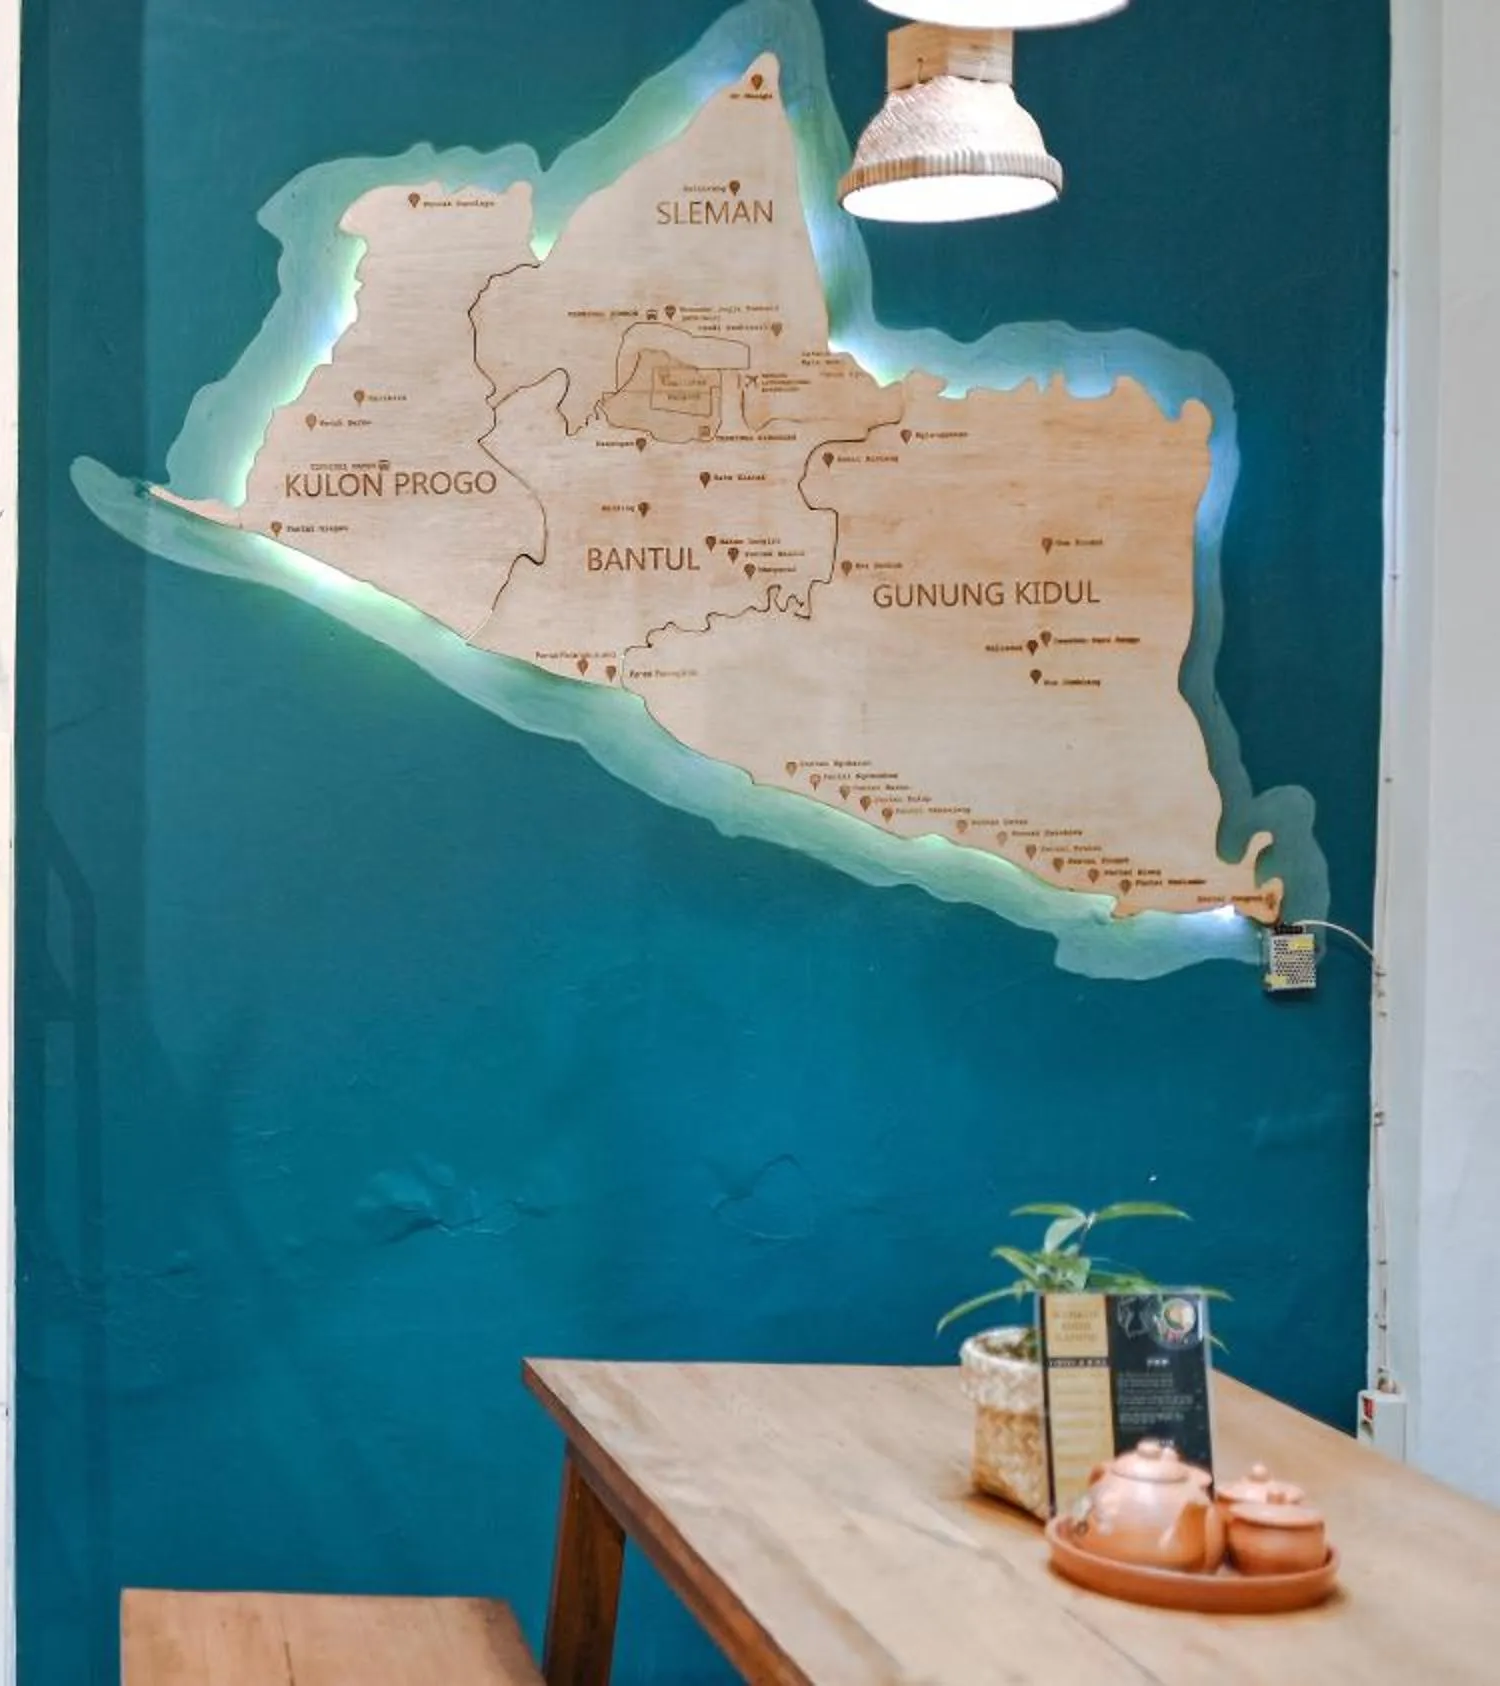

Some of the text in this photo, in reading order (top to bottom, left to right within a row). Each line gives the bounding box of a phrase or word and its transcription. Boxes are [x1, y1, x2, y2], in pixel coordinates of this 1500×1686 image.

[656, 200, 775, 225] SLEMAN
[285, 471, 497, 499] KULON PROGO
[586, 547, 701, 571] BANTUL
[872, 579, 1101, 609] GUNUNG KIDUL
